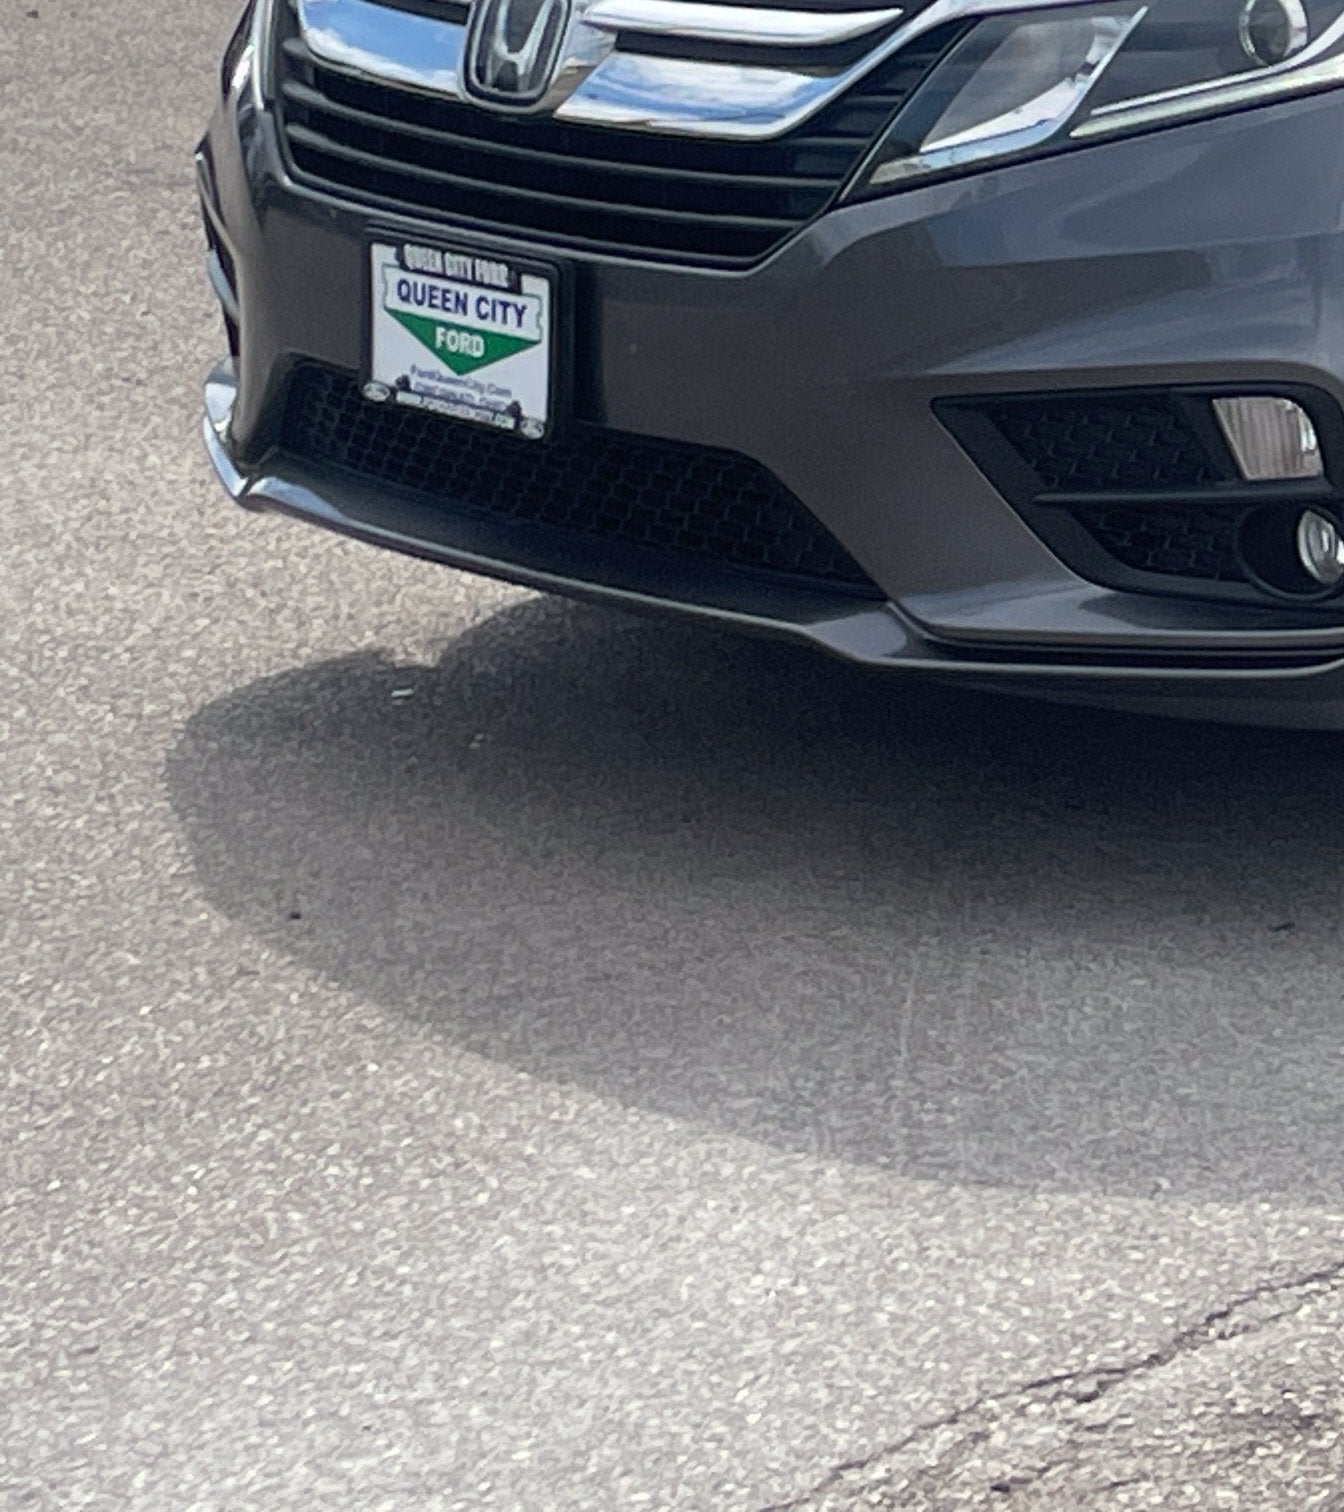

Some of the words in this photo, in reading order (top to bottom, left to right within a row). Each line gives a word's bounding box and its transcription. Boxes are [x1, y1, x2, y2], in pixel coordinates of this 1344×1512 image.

[397, 278, 469, 316] QUEEN
[475, 296, 528, 329] CITY
[434, 325, 486, 359] FORD
